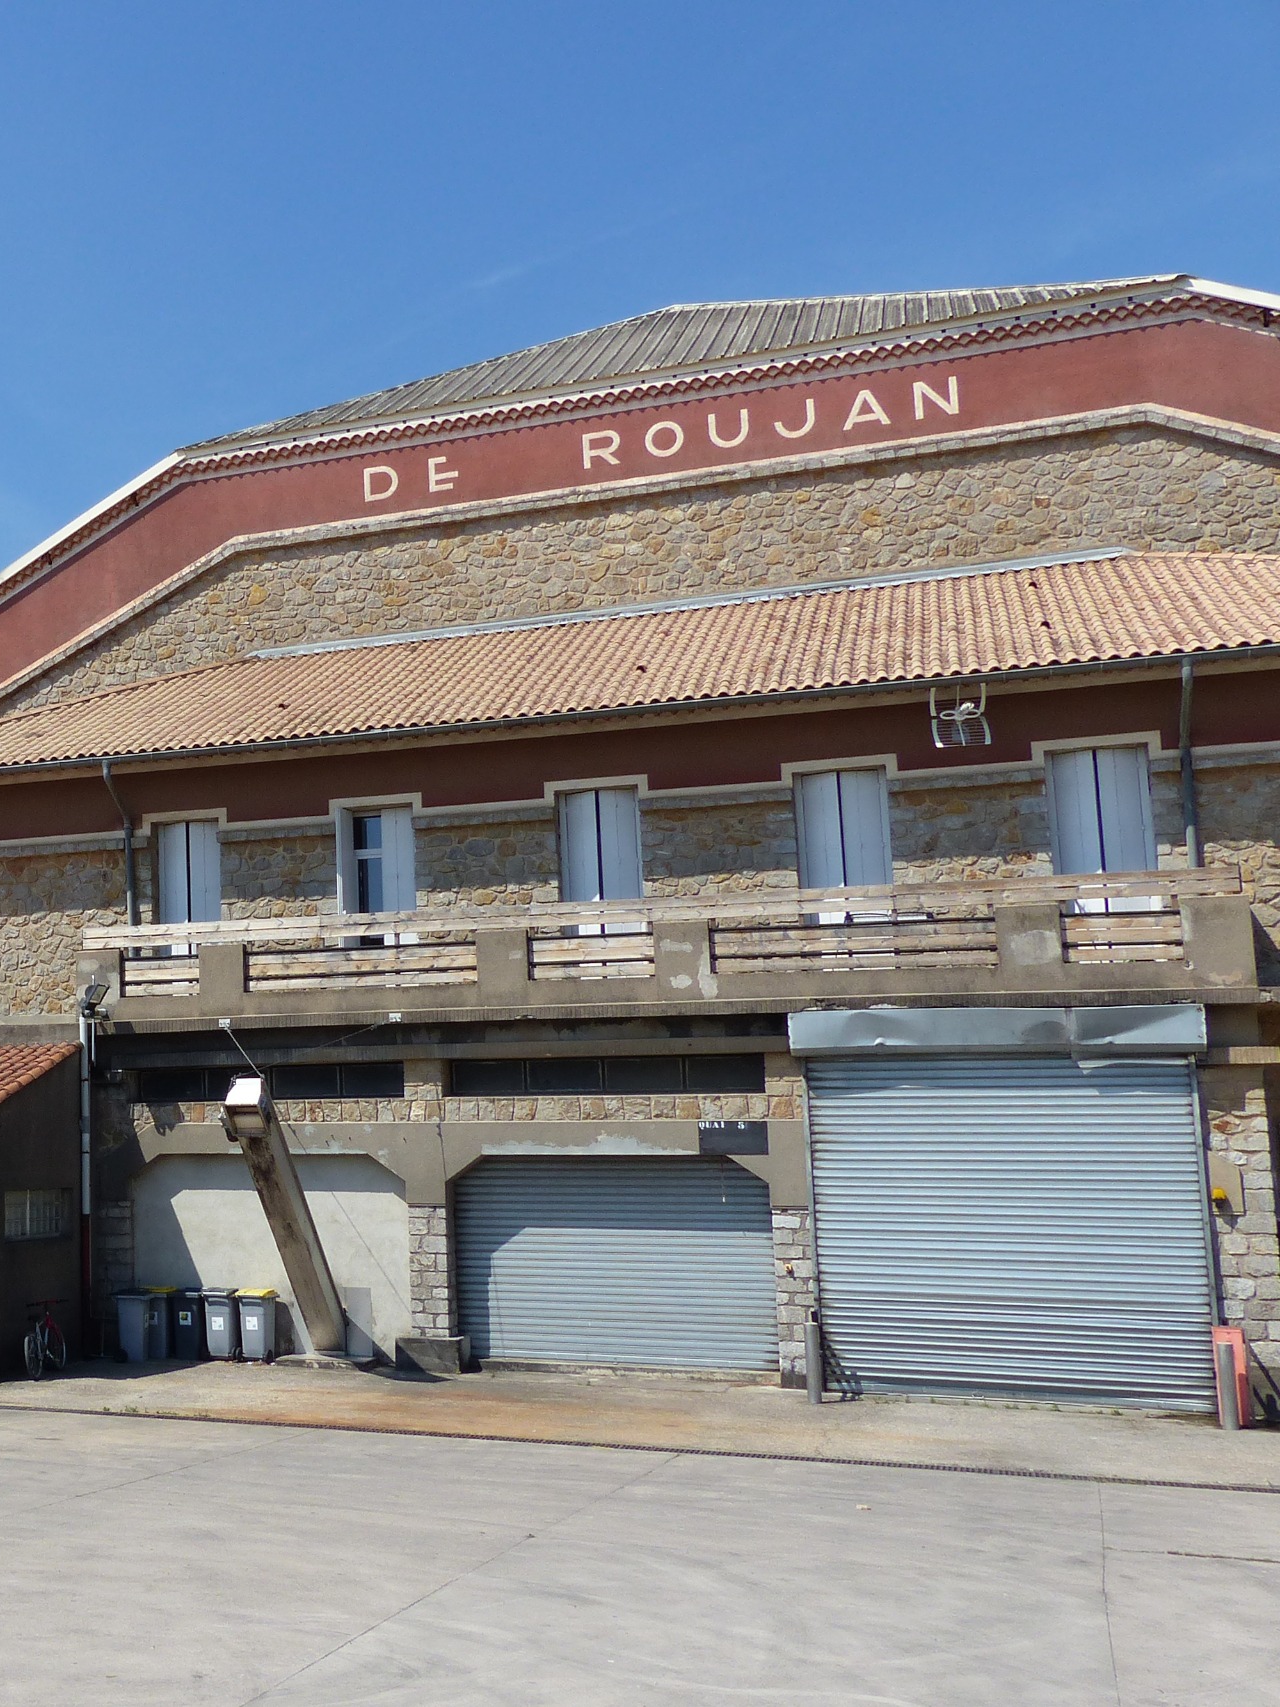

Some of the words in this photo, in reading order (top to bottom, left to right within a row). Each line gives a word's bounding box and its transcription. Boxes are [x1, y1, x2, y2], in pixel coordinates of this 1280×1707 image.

[362, 455, 460, 503] DE
[581, 375, 961, 470] ROUJAN
[698, 1121, 725, 1130] QUAI
